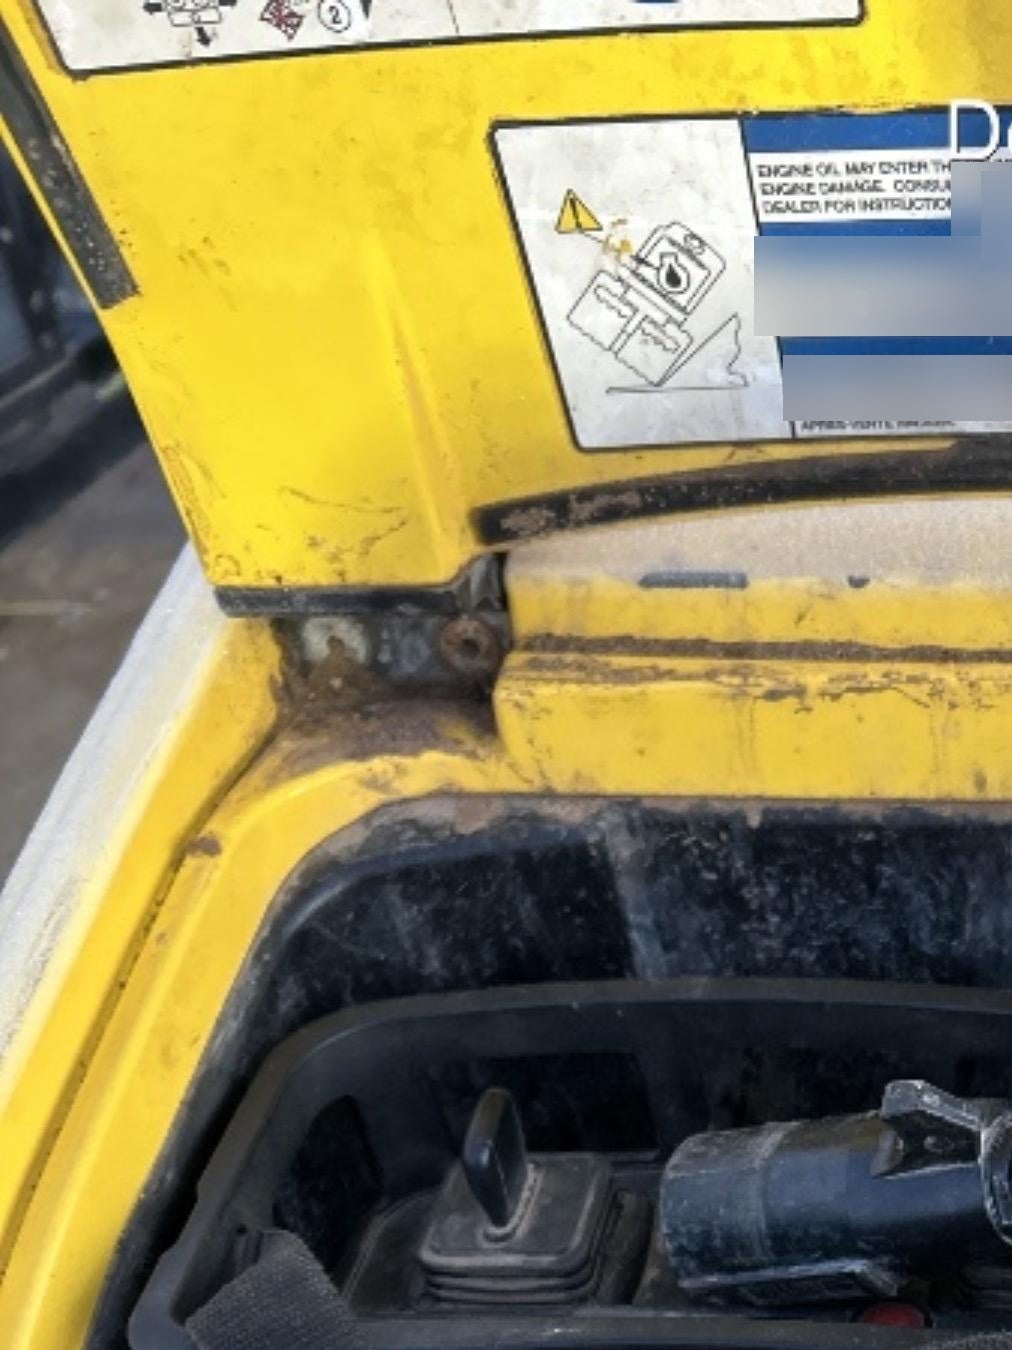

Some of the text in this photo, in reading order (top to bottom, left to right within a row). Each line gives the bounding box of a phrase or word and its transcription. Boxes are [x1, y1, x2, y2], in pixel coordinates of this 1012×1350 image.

[329, 5, 342, 24] 2
[757, 164, 814, 178] ENGINE
[815, 162, 840, 177] OIL
[845, 161, 876, 175] MAY
[879, 160, 929, 175] ENTER
[759, 182, 817, 196] ENGINE
[762, 200, 822, 214] DEALER
[825, 199, 856, 213] FOR
